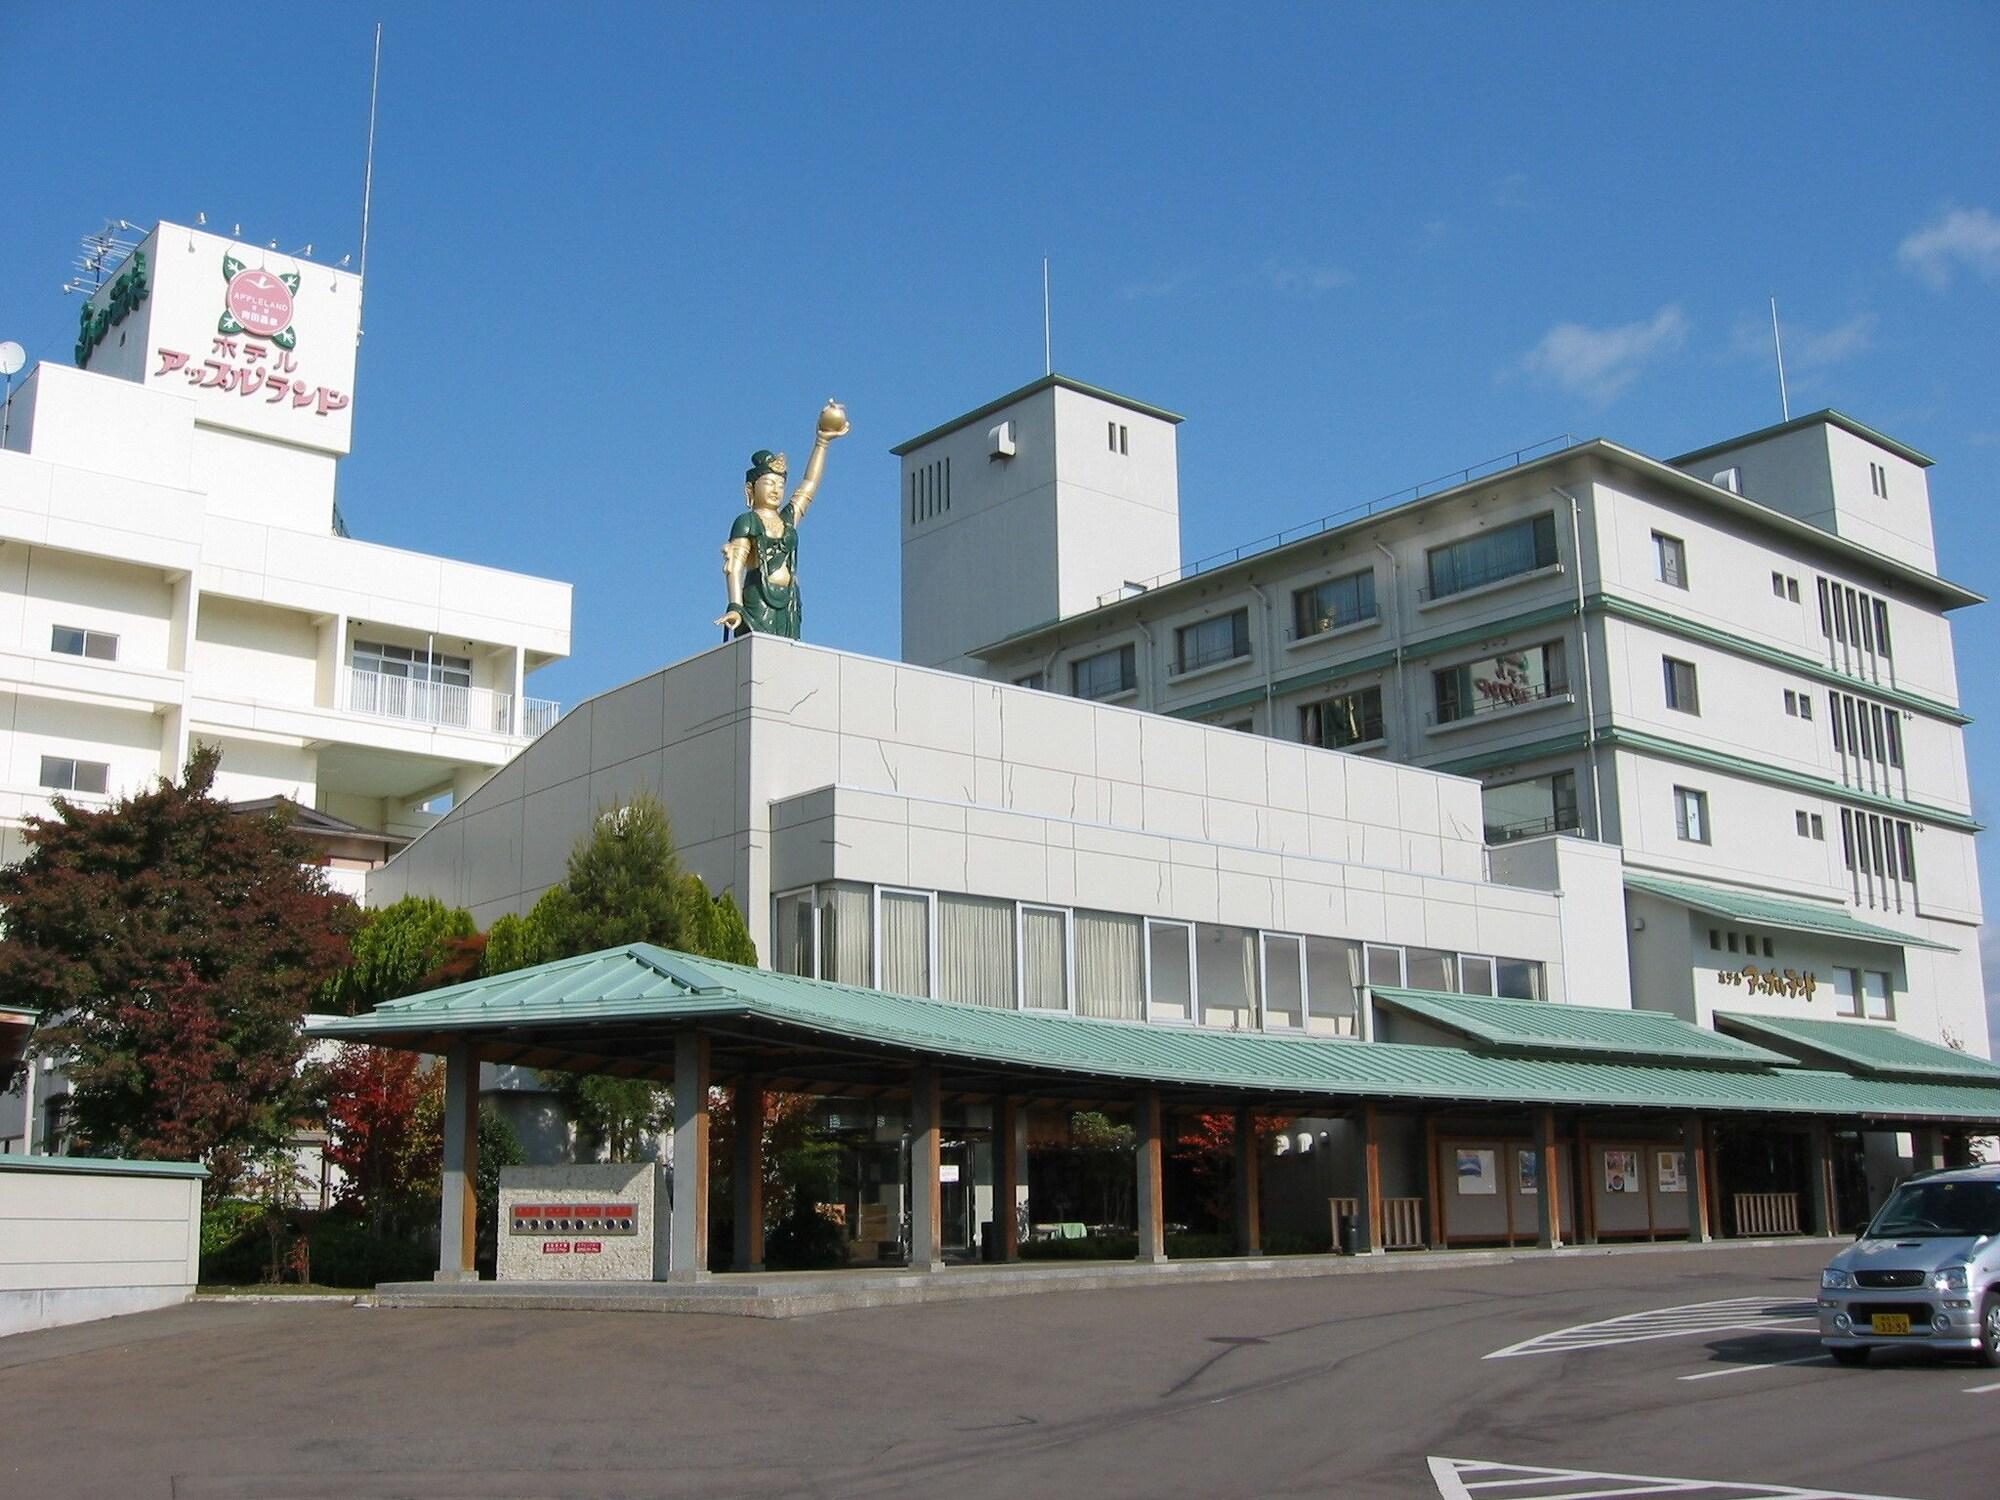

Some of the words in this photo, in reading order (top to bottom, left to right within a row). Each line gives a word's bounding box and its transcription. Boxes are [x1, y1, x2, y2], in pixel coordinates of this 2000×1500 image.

[233, 292, 288, 312] APPLELAND
[212, 337, 298, 373] ホテル
[154, 348, 350, 416] アップルランド
